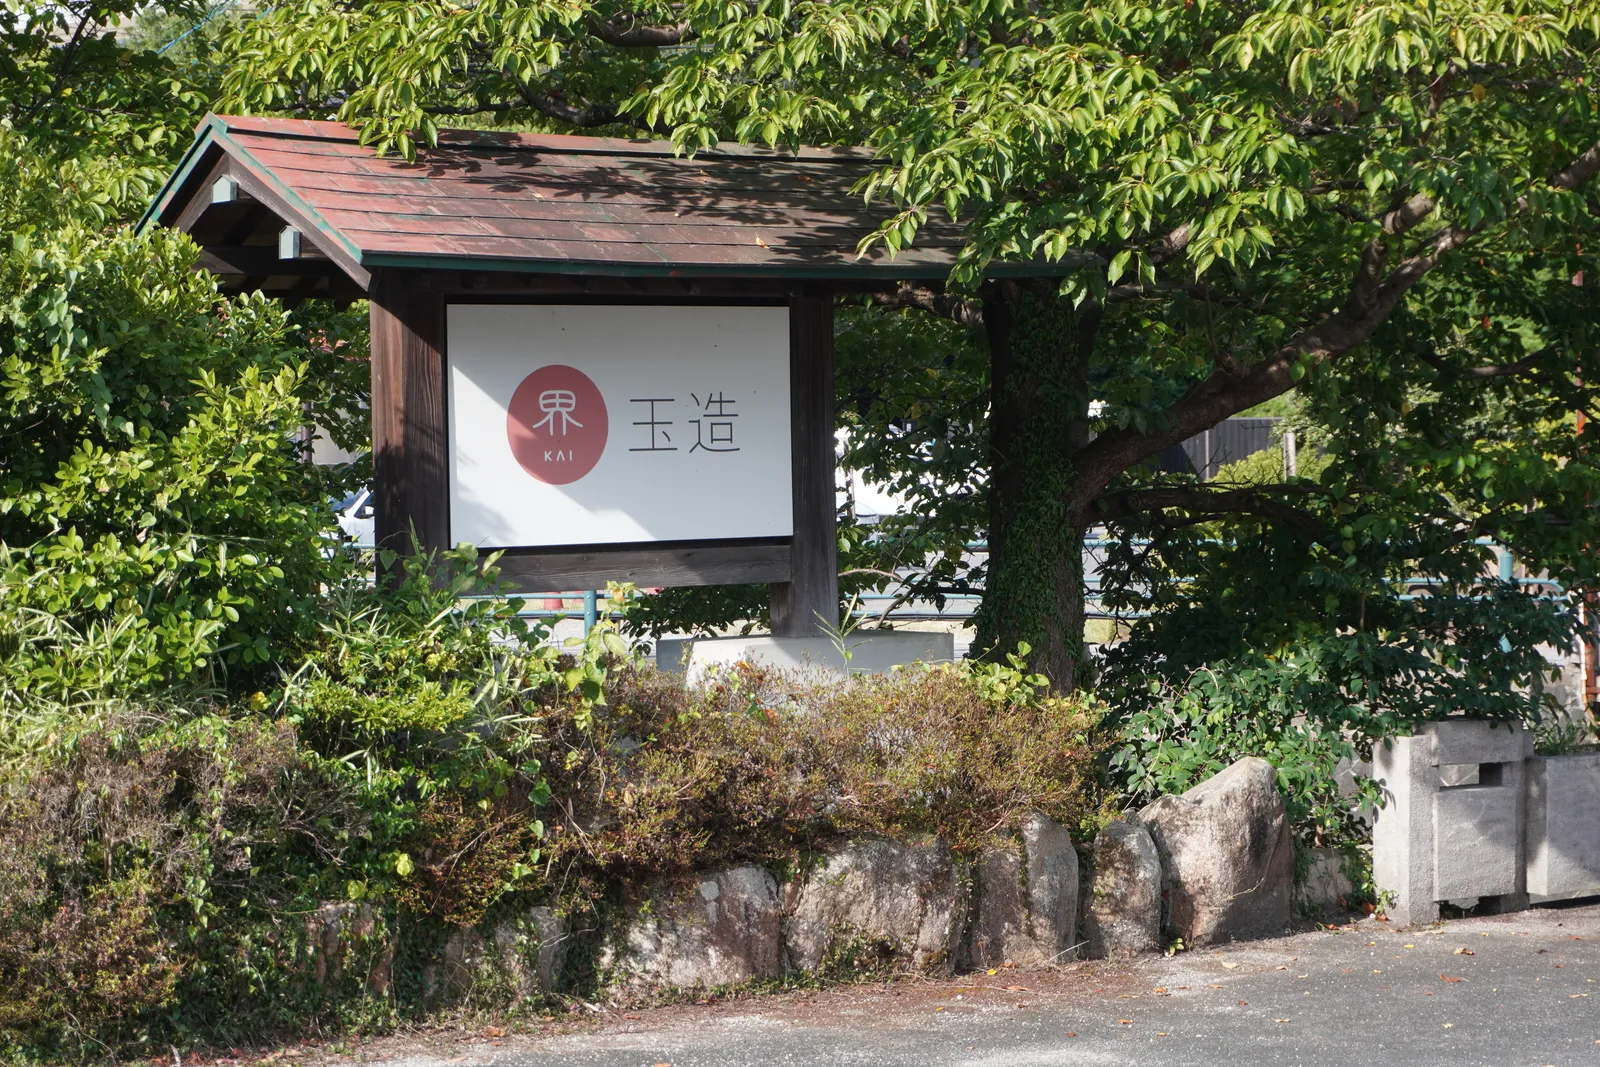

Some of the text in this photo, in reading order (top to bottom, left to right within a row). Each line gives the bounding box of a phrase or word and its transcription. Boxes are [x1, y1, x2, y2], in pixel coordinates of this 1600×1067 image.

[532, 389, 584, 436] 界
[628, 391, 741, 453] 玉造
[543, 449, 573, 462] KAI
